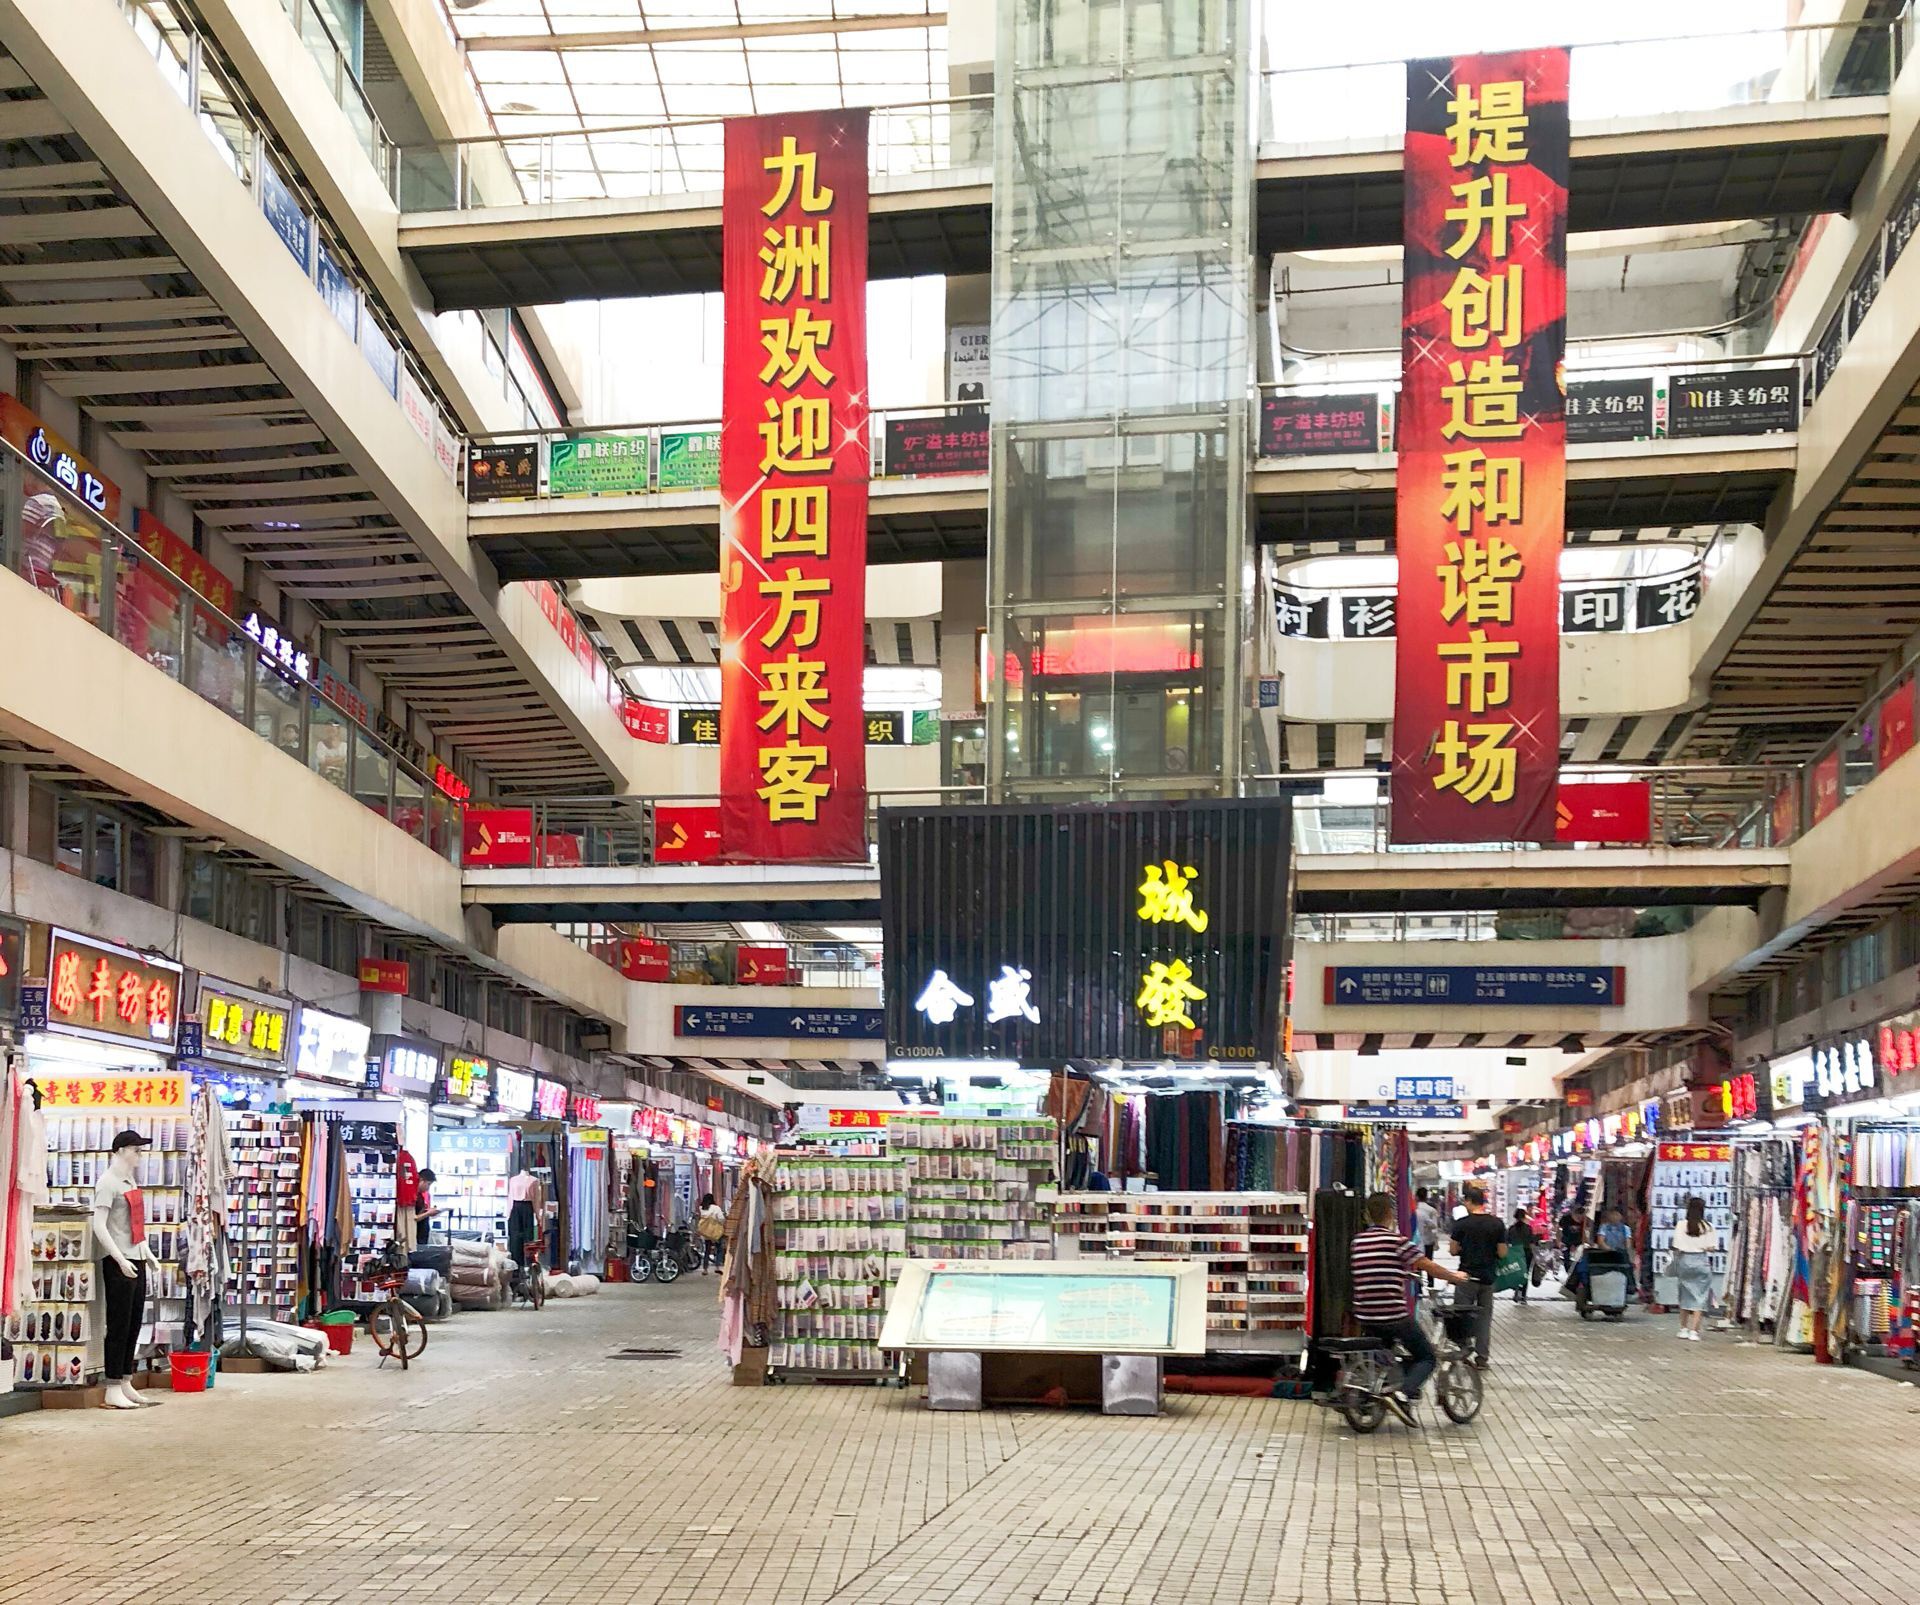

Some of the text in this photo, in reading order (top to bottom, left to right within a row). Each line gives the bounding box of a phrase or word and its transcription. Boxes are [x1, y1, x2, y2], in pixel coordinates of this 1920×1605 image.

[1706, 386, 1789, 409] 佳美纺织
[1433, 80, 1529, 804] 提升创造和谐市场
[757, 136, 834, 822] 九洲欢迎四方来客
[692, 720, 894, 743] 佳 织
[1209, 1046, 1256, 1058] G1000
[1396, 1079, 1452, 1097] 经四街
